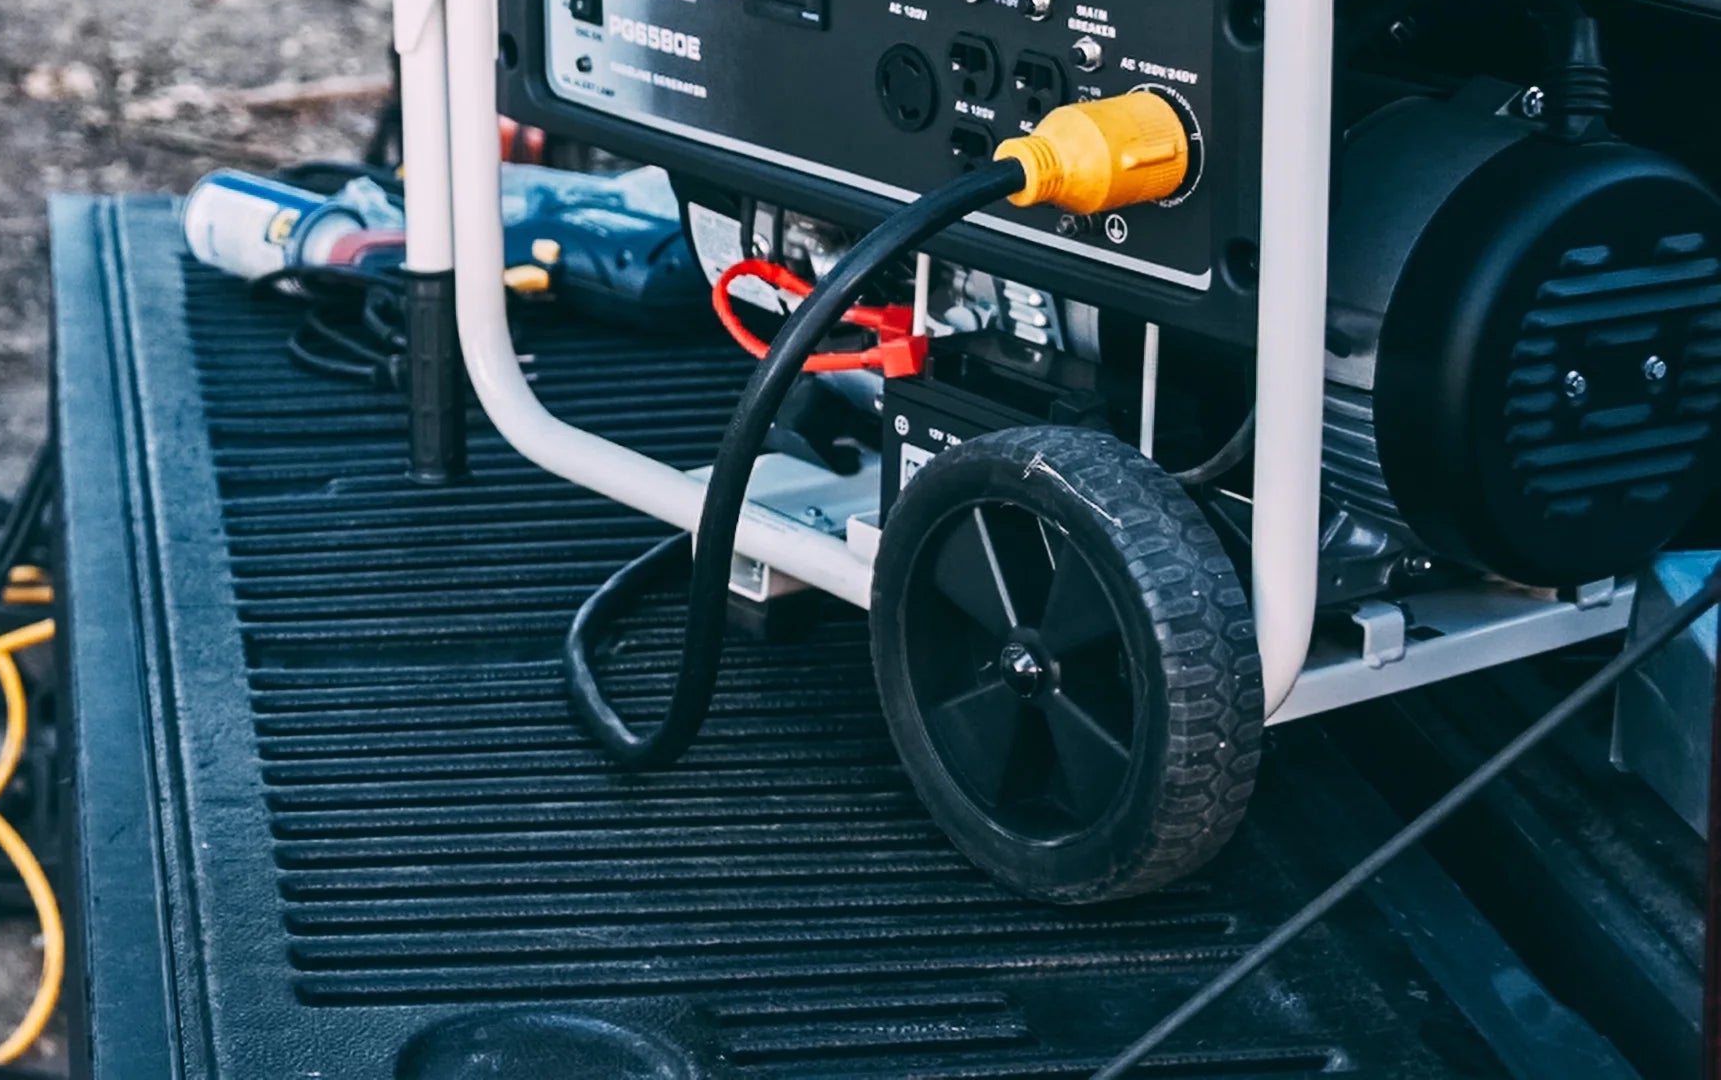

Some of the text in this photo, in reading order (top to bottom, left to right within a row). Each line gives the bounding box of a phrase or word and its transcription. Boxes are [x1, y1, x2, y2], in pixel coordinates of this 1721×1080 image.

[888, 1, 902, 15] AC
[1075, 4, 1108, 22] MAIN
[1067, 17, 1117, 39] BREAKER
[608, 14, 702, 62] PG6580E
[1120, 56, 1136, 70] AC
[954, 99, 968, 114] AC
